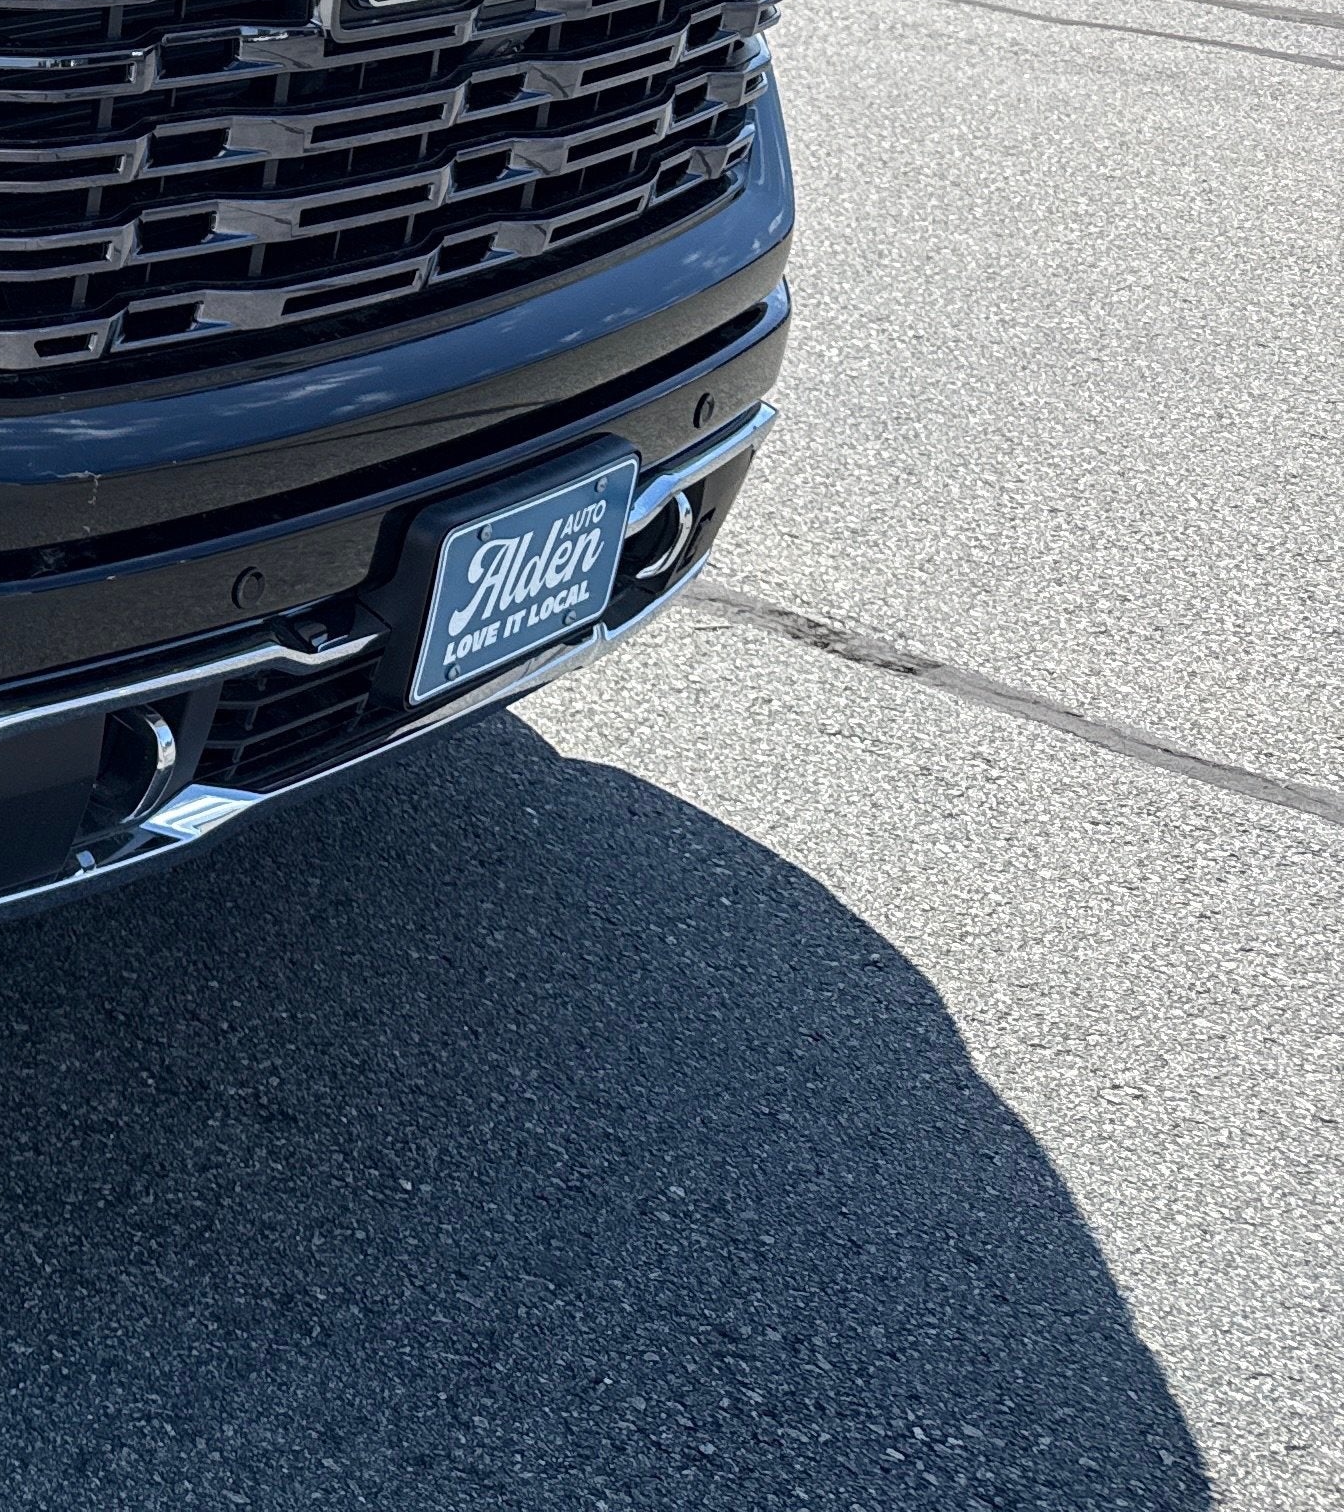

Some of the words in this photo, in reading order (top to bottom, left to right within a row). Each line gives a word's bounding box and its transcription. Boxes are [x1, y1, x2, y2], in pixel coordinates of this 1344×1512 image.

[560, 499, 607, 540] AUTO
[447, 518, 606, 636] Alden
[443, 621, 500, 666] LOVE
[503, 613, 528, 639] IT
[528, 580, 590, 625] LOCAL
